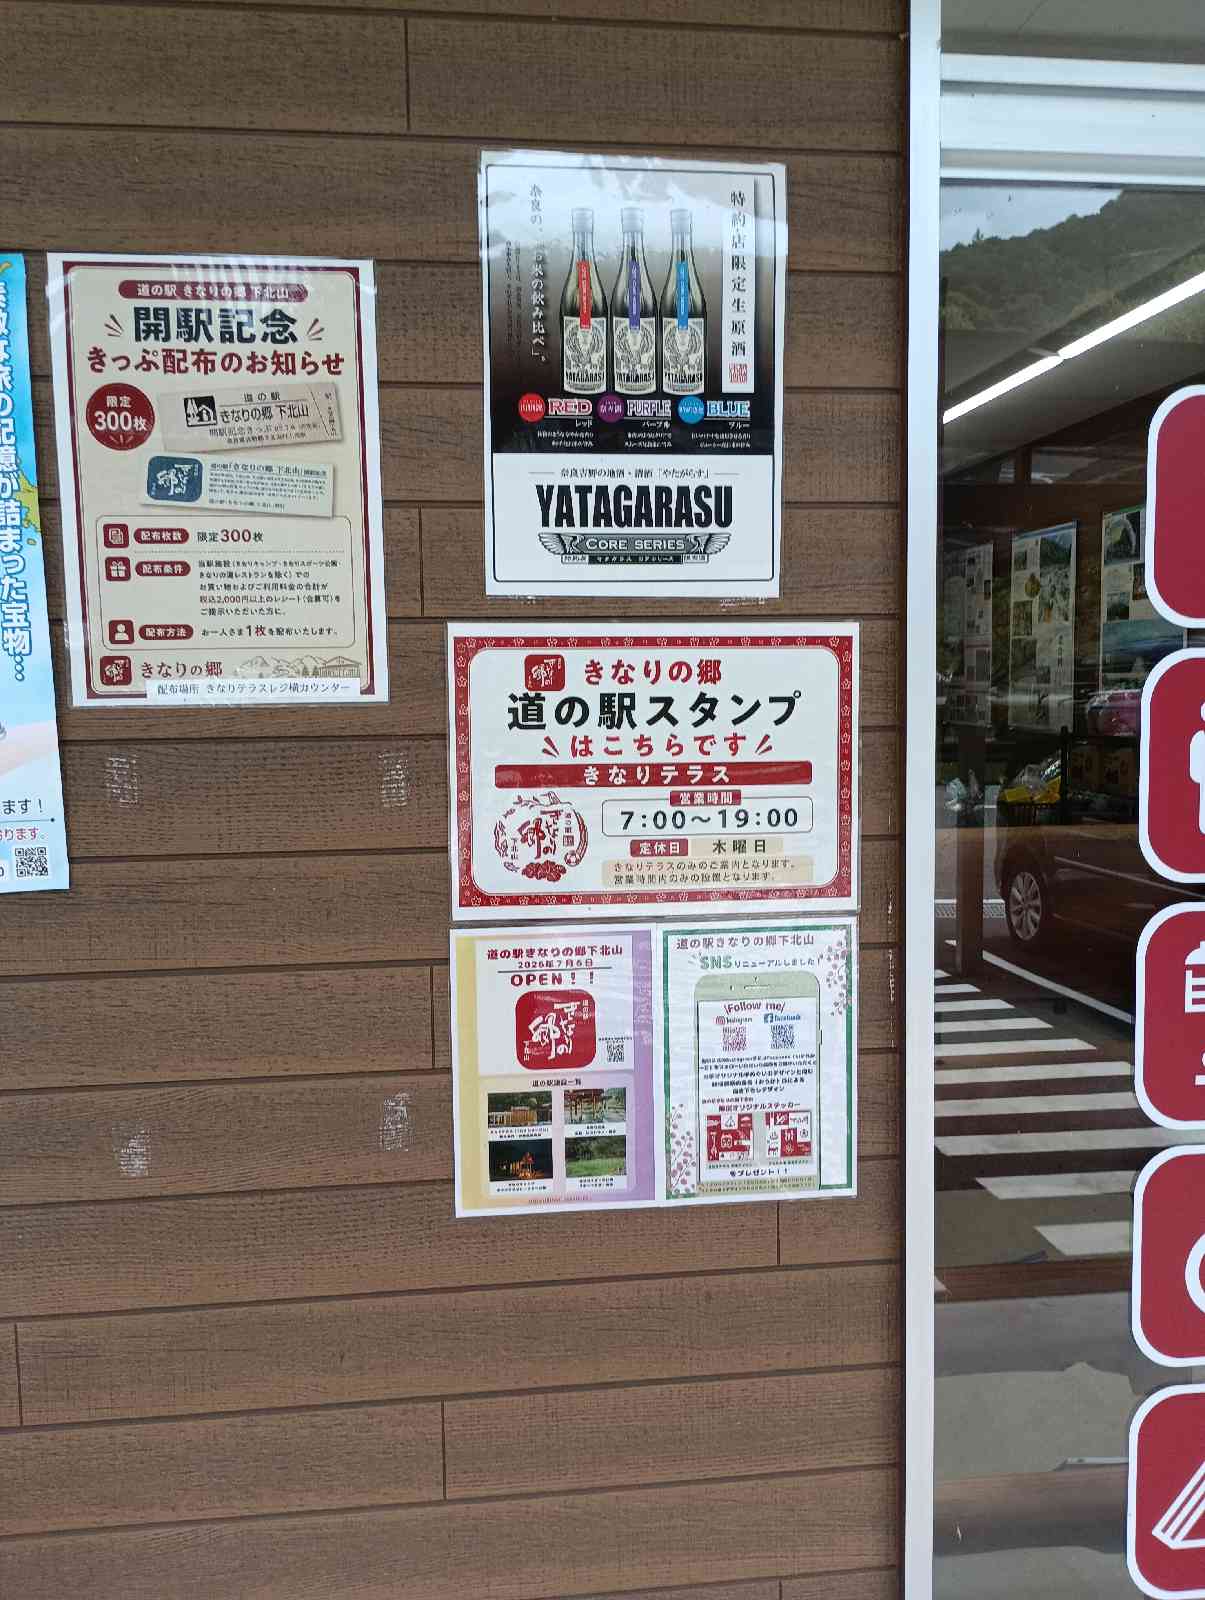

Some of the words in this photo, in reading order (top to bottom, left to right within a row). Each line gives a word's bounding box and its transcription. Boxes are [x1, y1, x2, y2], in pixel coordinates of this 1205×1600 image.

[730, 190, 747, 357] 特約店限定生原酒
[137, 283, 177, 297] 道の駅
[133, 306, 298, 344] 開駅記念
[87, 347, 345, 376] きっぷ配布のお知らせ
[106, 396, 131, 408] 限定
[548, 398, 593, 416] RED
[627, 399, 671, 417] PURPLE
[706, 400, 751, 417] BLUE
[94, 411, 147, 431] 300枚
[219, 407, 273, 423] きなりの郷
[275, 404, 310, 419] 下北山
[535, 484, 733, 528] YATAGARASU
[196, 529, 264, 543] 限定300枚
[585, 538, 628, 550] CORE
[634, 539, 685, 550] SERIES
[145, 627, 187, 639] 配布方法
[141, 660, 223, 678] きなりの郷
[584, 659, 722, 685] きなりの郷
[157, 684, 199, 696] 配布場所
[206, 683, 350, 695] きなりテラスレジ横カウンター
[507, 690, 802, 731] 道の駅スタンプ
[570, 734, 748, 758] はこちらです
[583, 763, 731, 785] きなりテラス
[680, 792, 733, 805] 営業時間
[639, 841, 681, 855] 定休日
[712, 839, 767, 854] 木曜日
[676, 936, 814, 949] 道の駅きなりの郷下北山
[487, 945, 623, 960] 道の駅きなりの郷下北山
